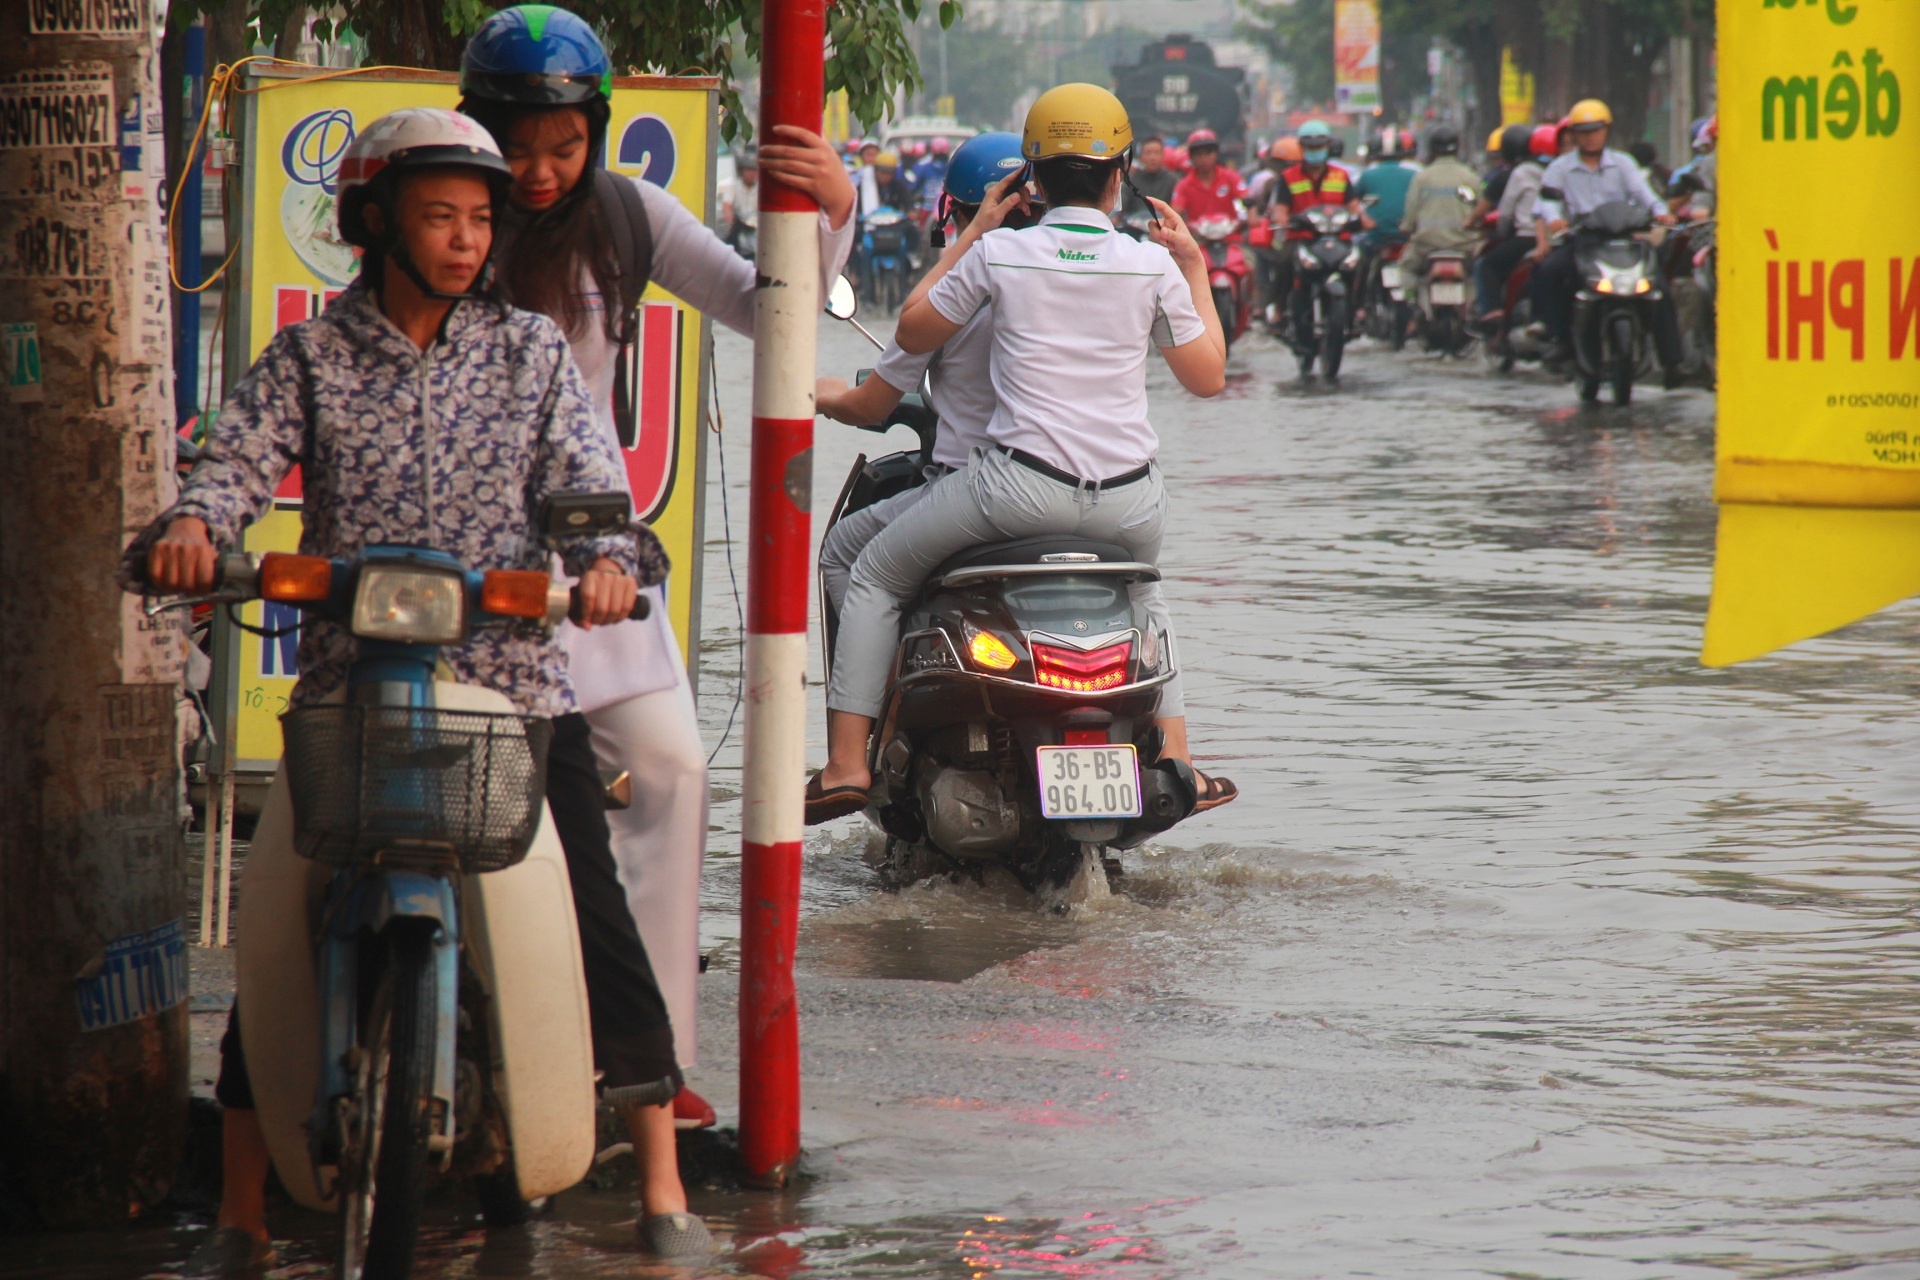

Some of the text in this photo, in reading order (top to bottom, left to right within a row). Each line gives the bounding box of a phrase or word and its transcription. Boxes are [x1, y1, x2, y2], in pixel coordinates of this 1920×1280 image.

[1055, 248, 1100, 261] Nidec
[1051, 750, 1122, 781] 36-B5
[1047, 783, 1133, 813] 964.00
